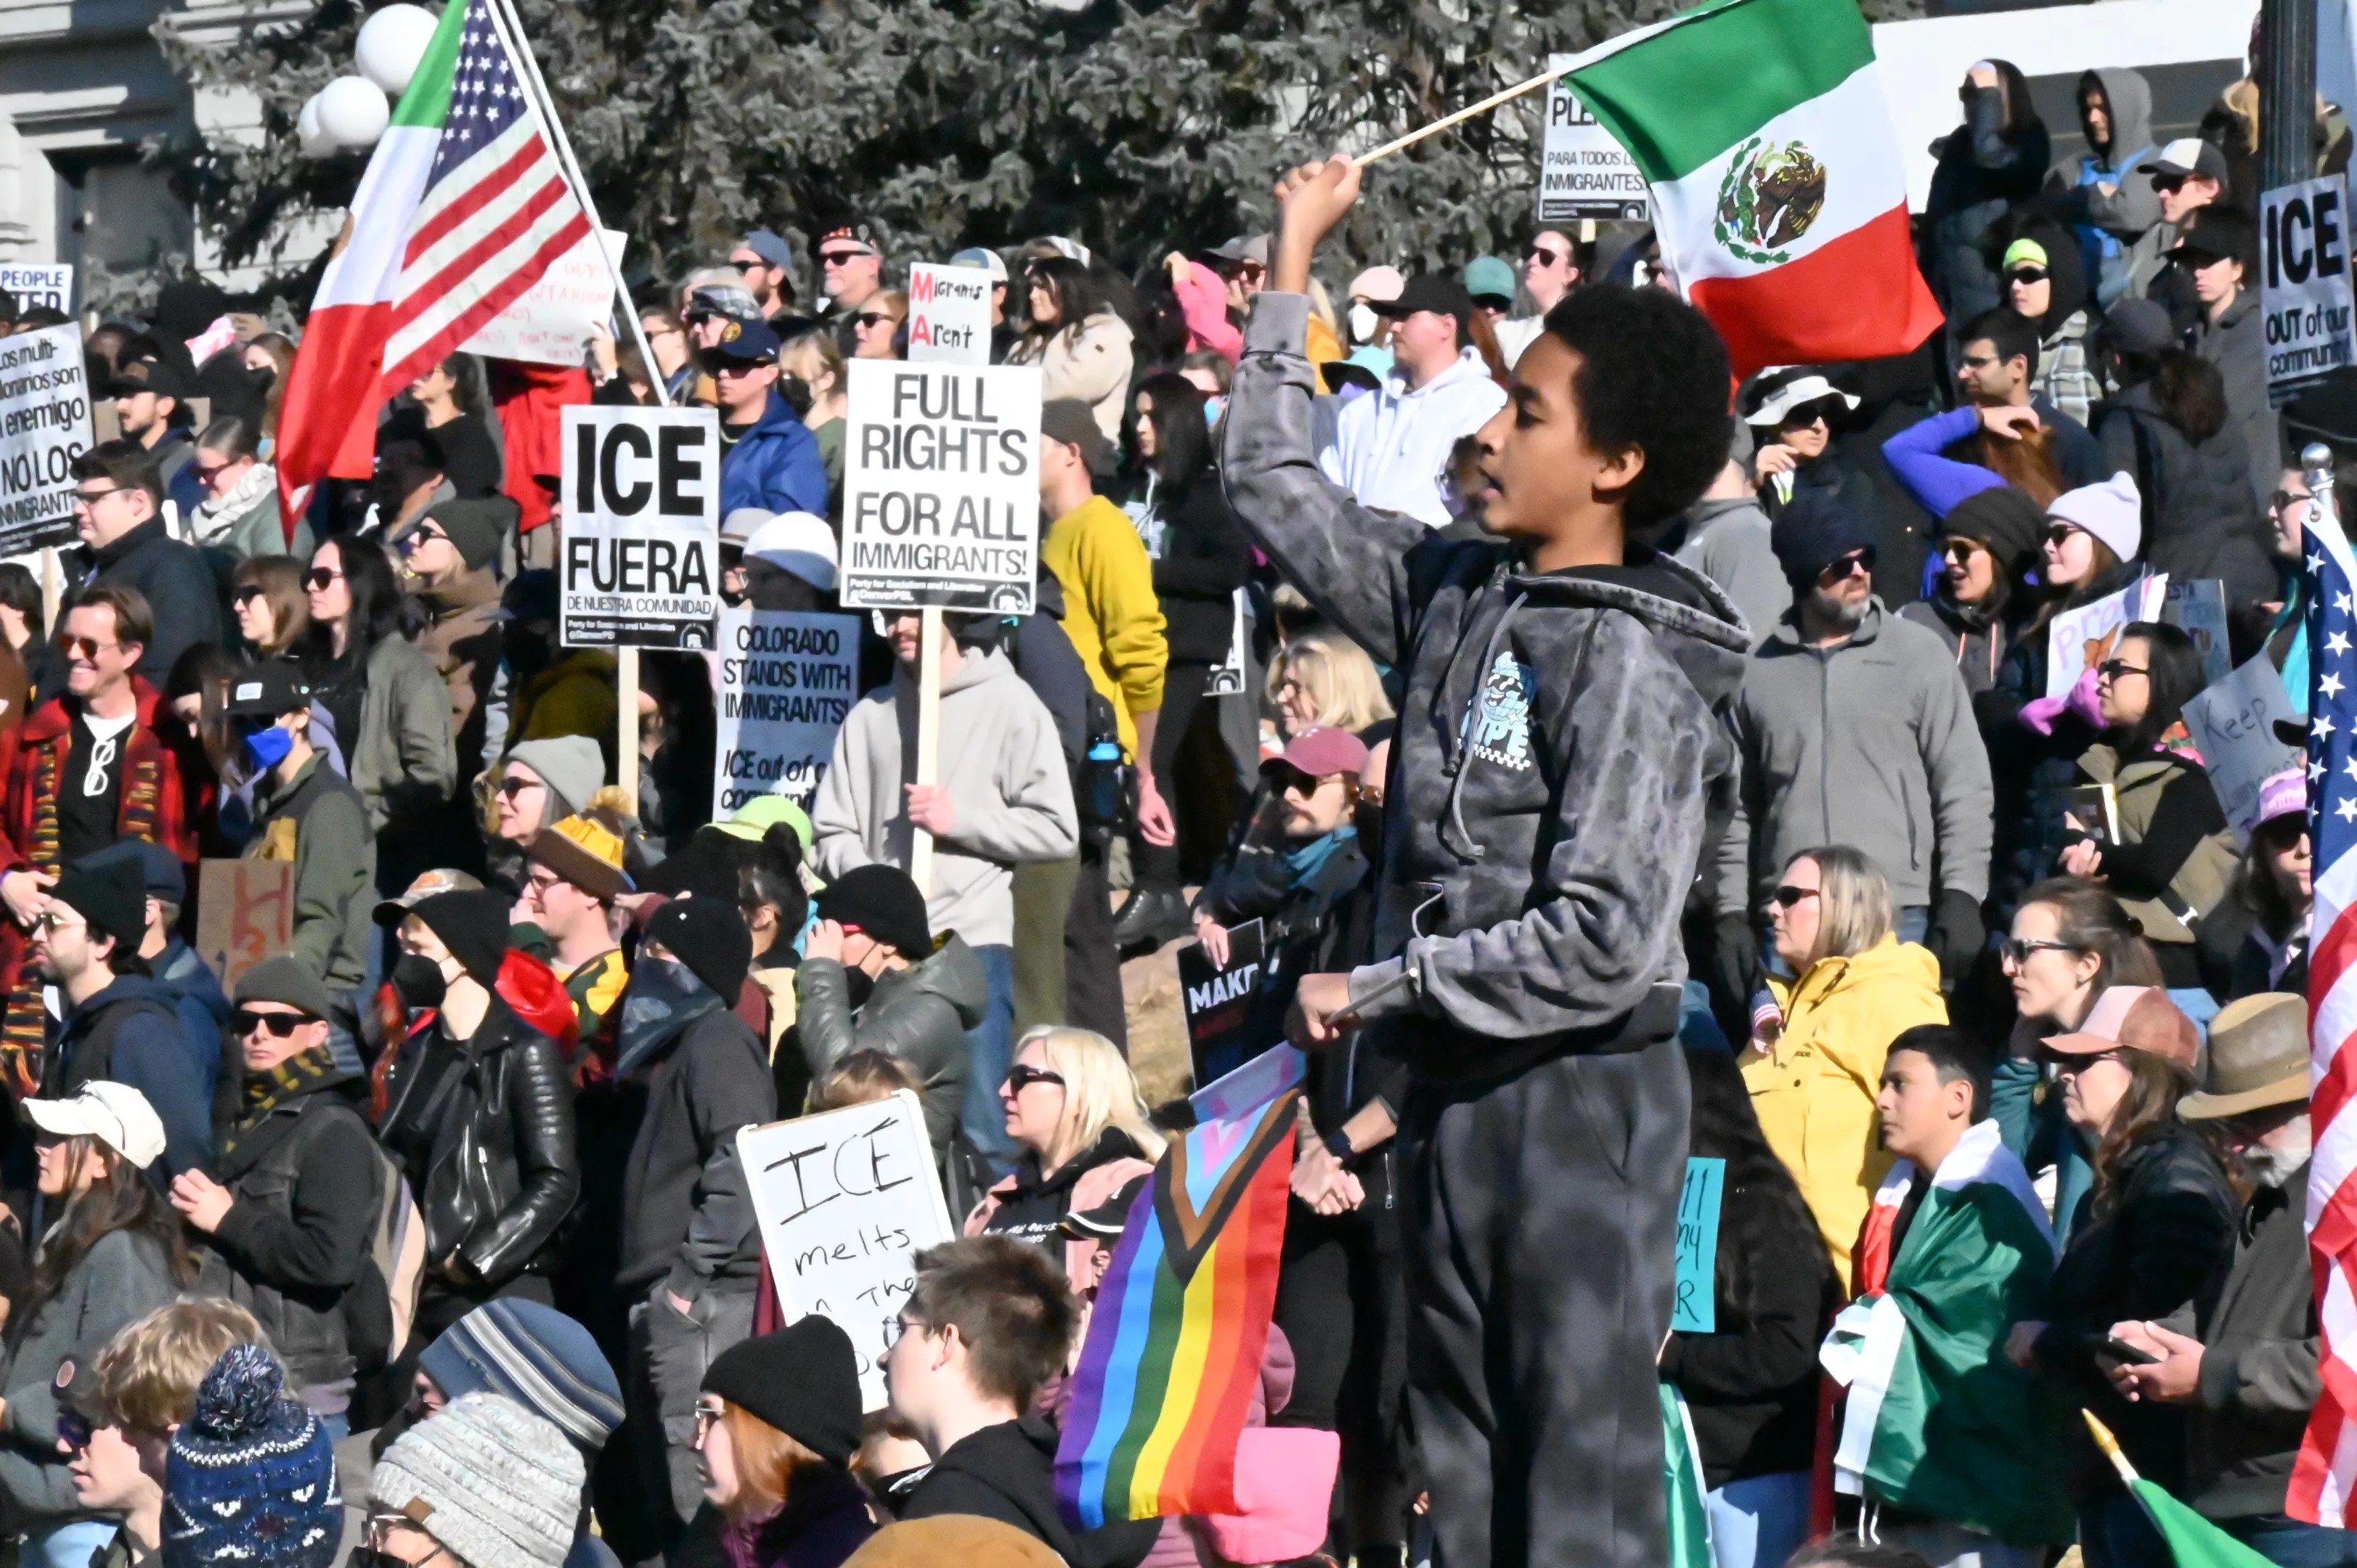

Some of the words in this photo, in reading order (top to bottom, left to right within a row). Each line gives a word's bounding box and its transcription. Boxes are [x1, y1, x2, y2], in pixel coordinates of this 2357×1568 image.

[1547, 151, 1577, 166] PARA
[1581, 151, 1621, 166] TODOS
[2267, 190, 2343, 289] ICE
[1, 270, 64, 287] PEOPLE
[910, 271, 983, 303] Migrants
[2266, 308, 2303, 346] OUT
[2305, 303, 2322, 337] of
[2326, 306, 2350, 333] our
[52, 366, 82, 388] son
[893, 373, 998, 423] FULL
[5, 395, 86, 437] enemigo
[577, 423, 706, 516] ICE
[861, 423, 1028, 476] RIGHTS
[1, 453, 31, 496] NO
[855, 491, 941, 536] FOR
[950, 495, 1027, 542] ALL
[568, 536, 711, 595] FUERA
[852, 542, 1027, 576] IMMIGRANTS!
[567, 596, 582, 610] DE
[584, 596, 633, 611] NUESTRA
[636, 598, 712, 615] COMUNIDAD
[736, 625, 839, 656] COLORADO
[723, 658, 797, 688] STANDS
[801, 662, 851, 691] WITH
[2197, 698, 2273, 752] Keep
[722, 749, 757, 779] ICE
[757, 754, 784, 781] out
[786, 753, 813, 783] of
[763, 1116, 913, 1226] ICE
[795, 1224, 911, 1276] melts
[855, 1276, 914, 1307] The
